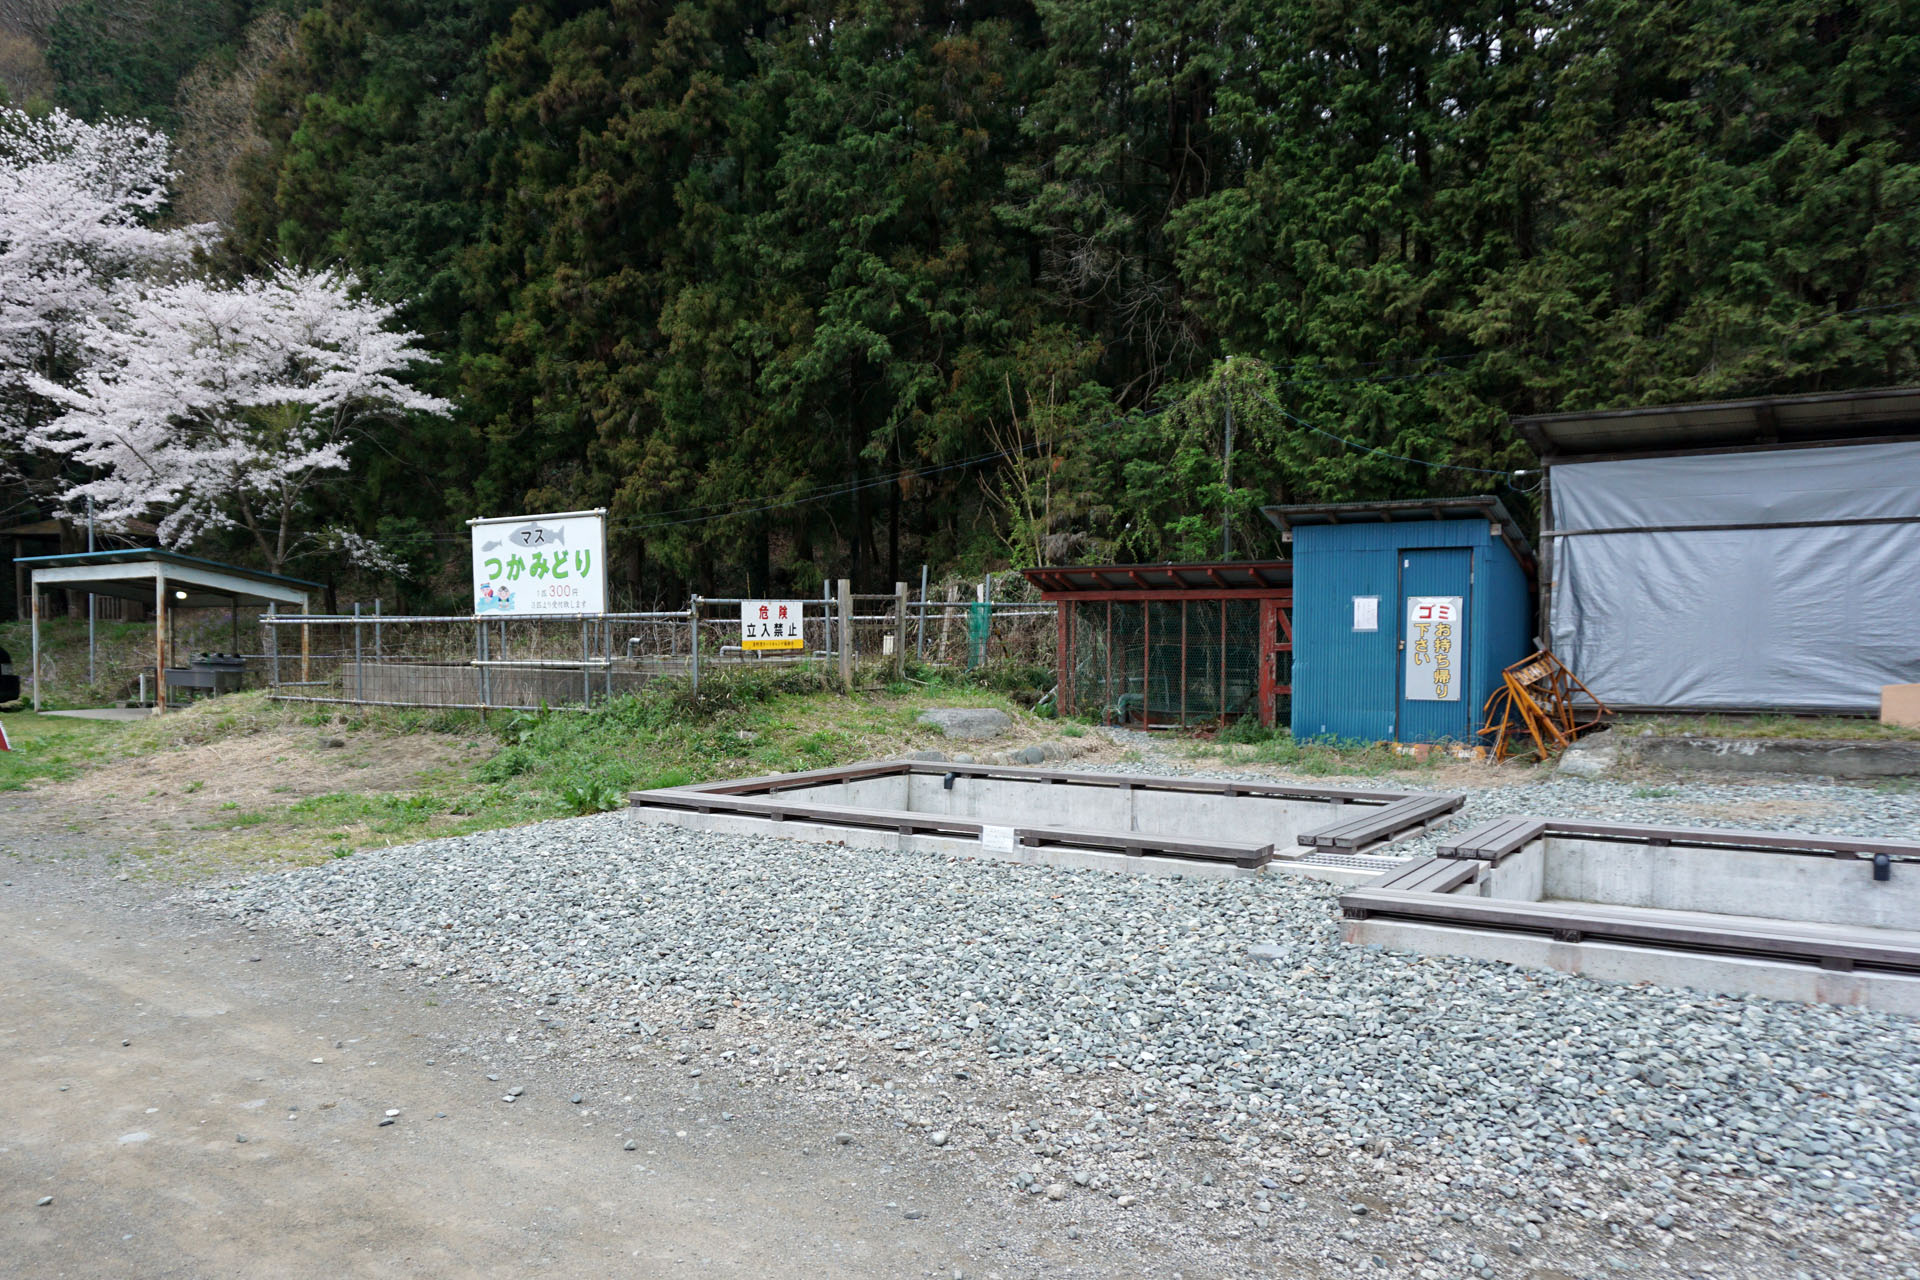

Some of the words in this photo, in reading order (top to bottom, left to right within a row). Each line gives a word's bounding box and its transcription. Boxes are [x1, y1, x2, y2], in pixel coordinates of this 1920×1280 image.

[521, 529, 545, 544] マス
[484, 549, 591, 580] つかみどり
[759, 605, 788, 620] 危険
[1419, 604, 1450, 620] ゴミ
[747, 622, 798, 638] 立入禁止
[1414, 623, 1431, 665] 下さい
[1434, 622, 1452, 699] お持ち帰り
